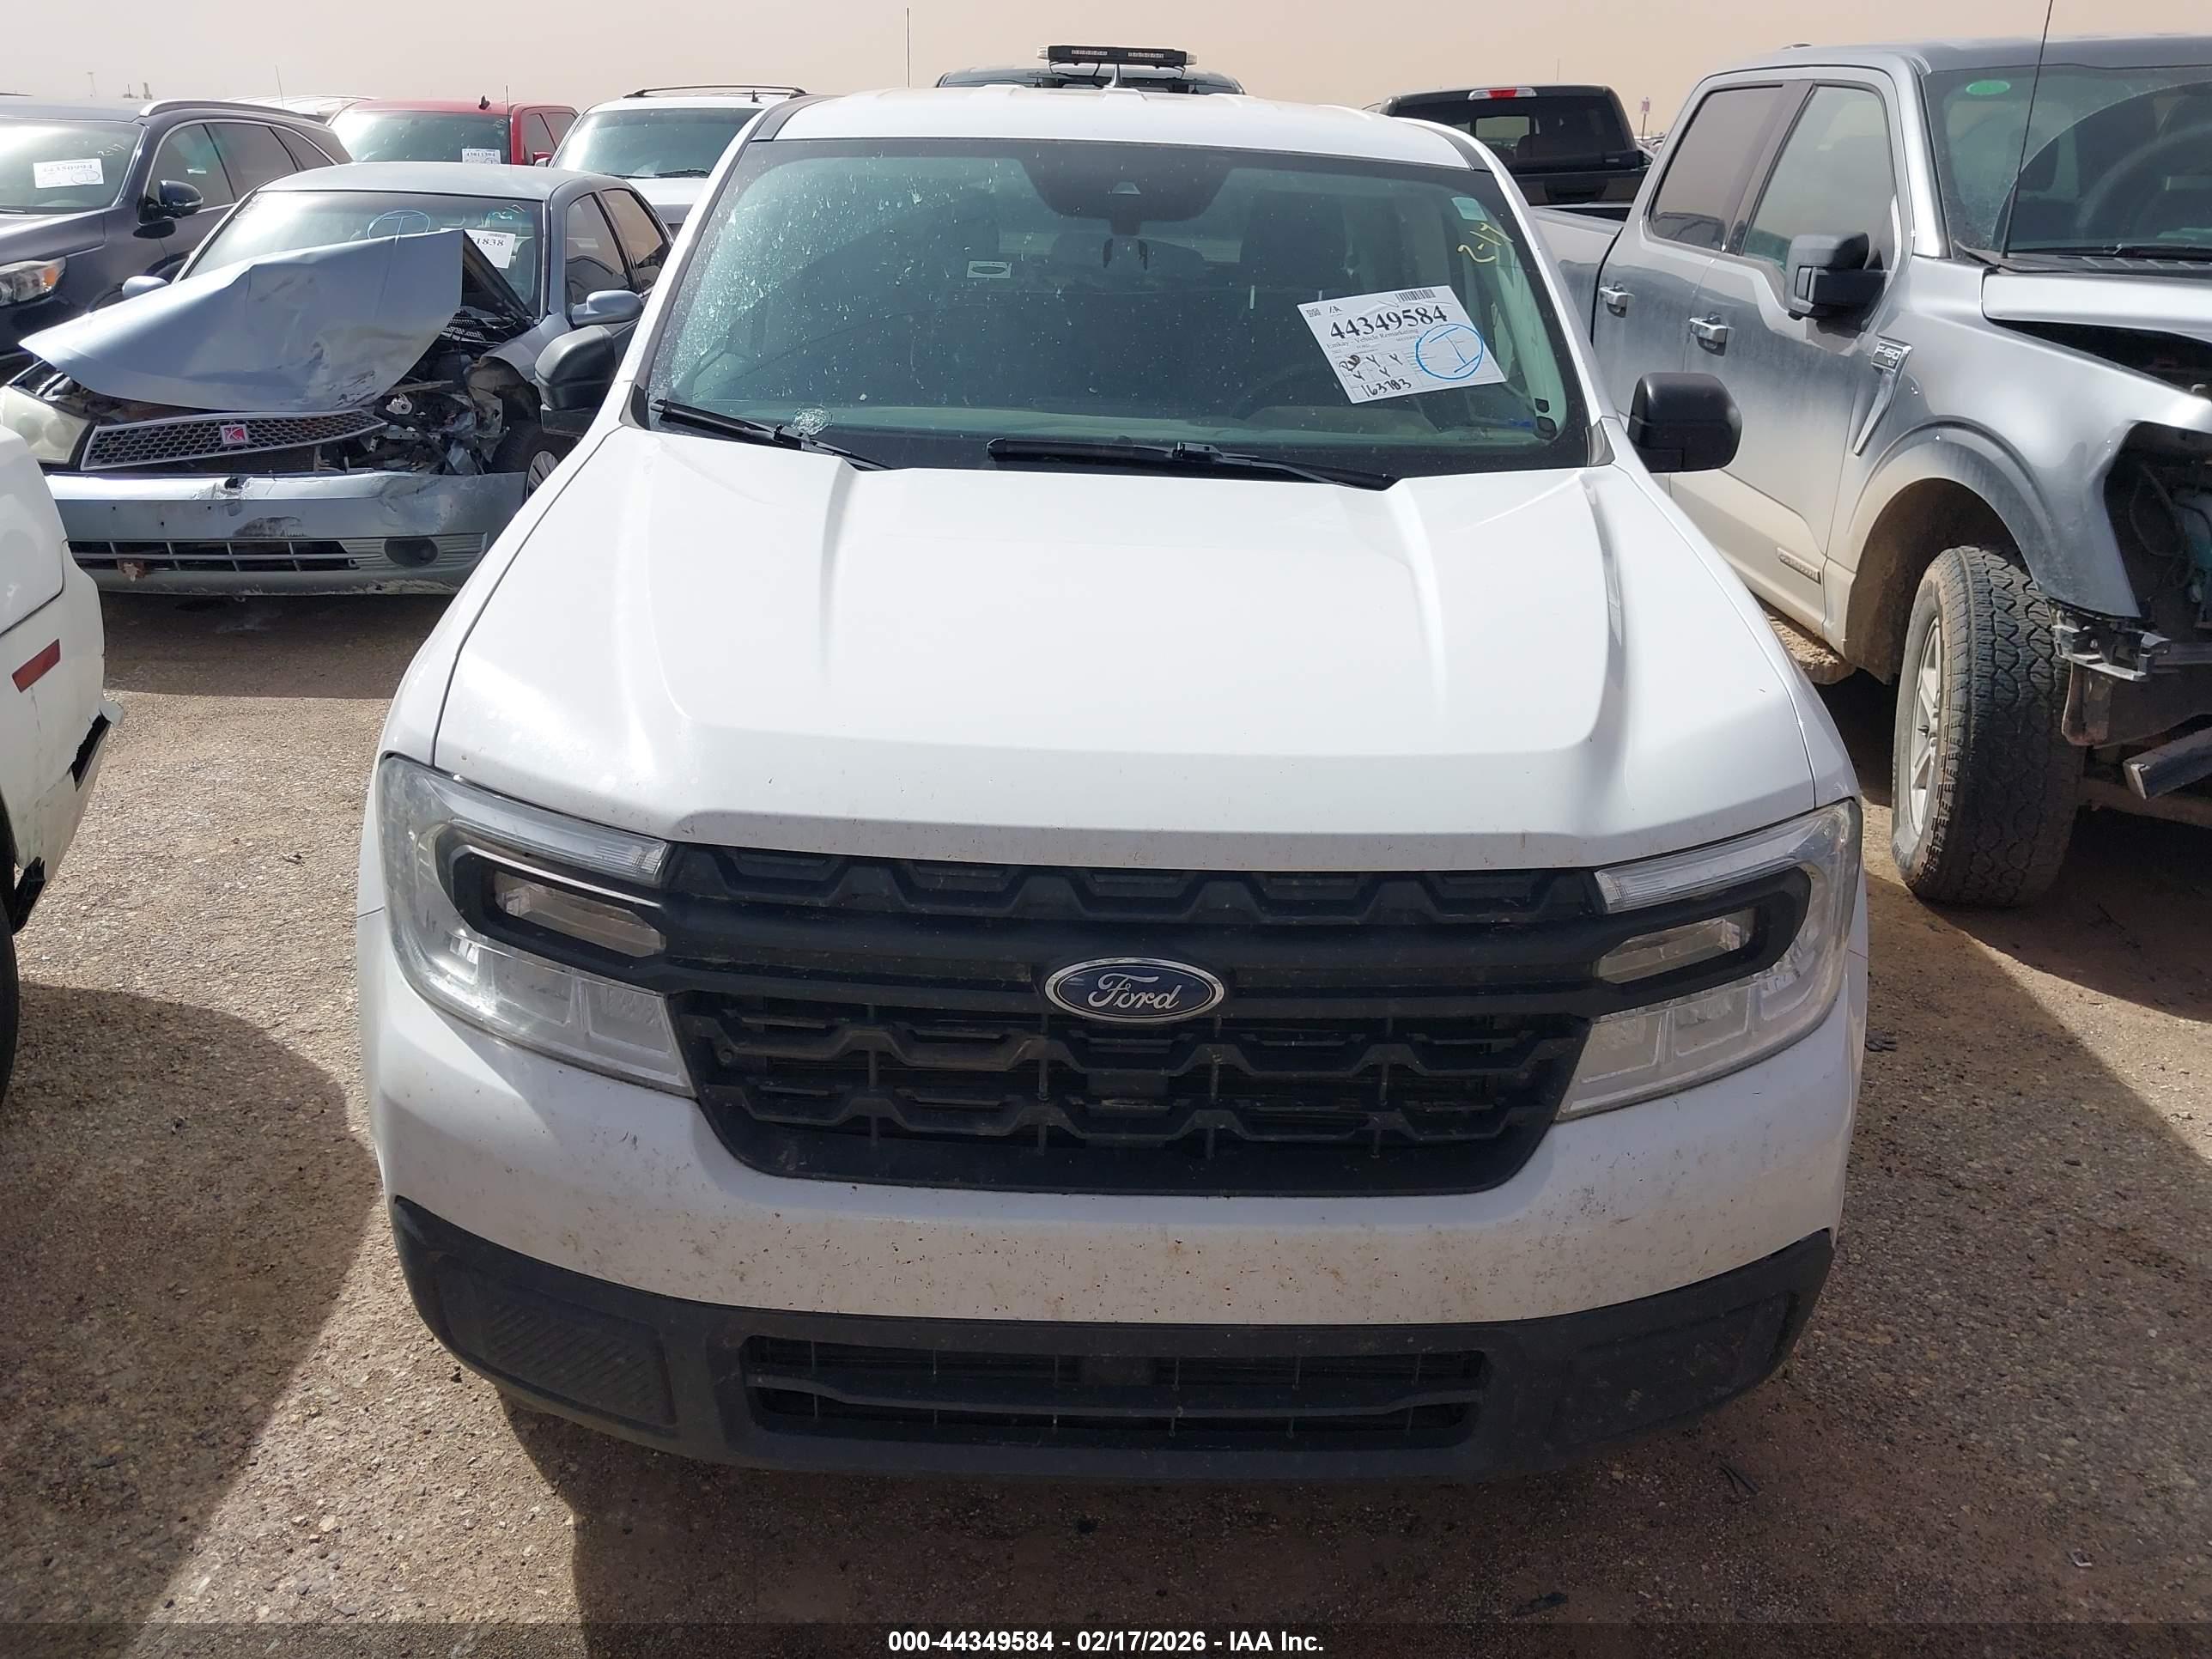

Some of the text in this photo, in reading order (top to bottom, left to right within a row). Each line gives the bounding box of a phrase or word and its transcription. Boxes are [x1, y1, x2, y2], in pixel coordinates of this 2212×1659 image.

[492, 204, 526, 220] 2-17
[471, 236, 505, 247] 1838
[1457, 222, 1514, 263] 2-17
[1330, 304, 1448, 339] 44349584
[1354, 333, 1377, 343] Vehicle
[1365, 355, 1381, 368] Y
[1389, 353, 1403, 366] Y
[1353, 367, 1391, 381] Y Y
[1360, 378, 1413, 398] 163783
[1088, 972, 1182, 1010] Ford
